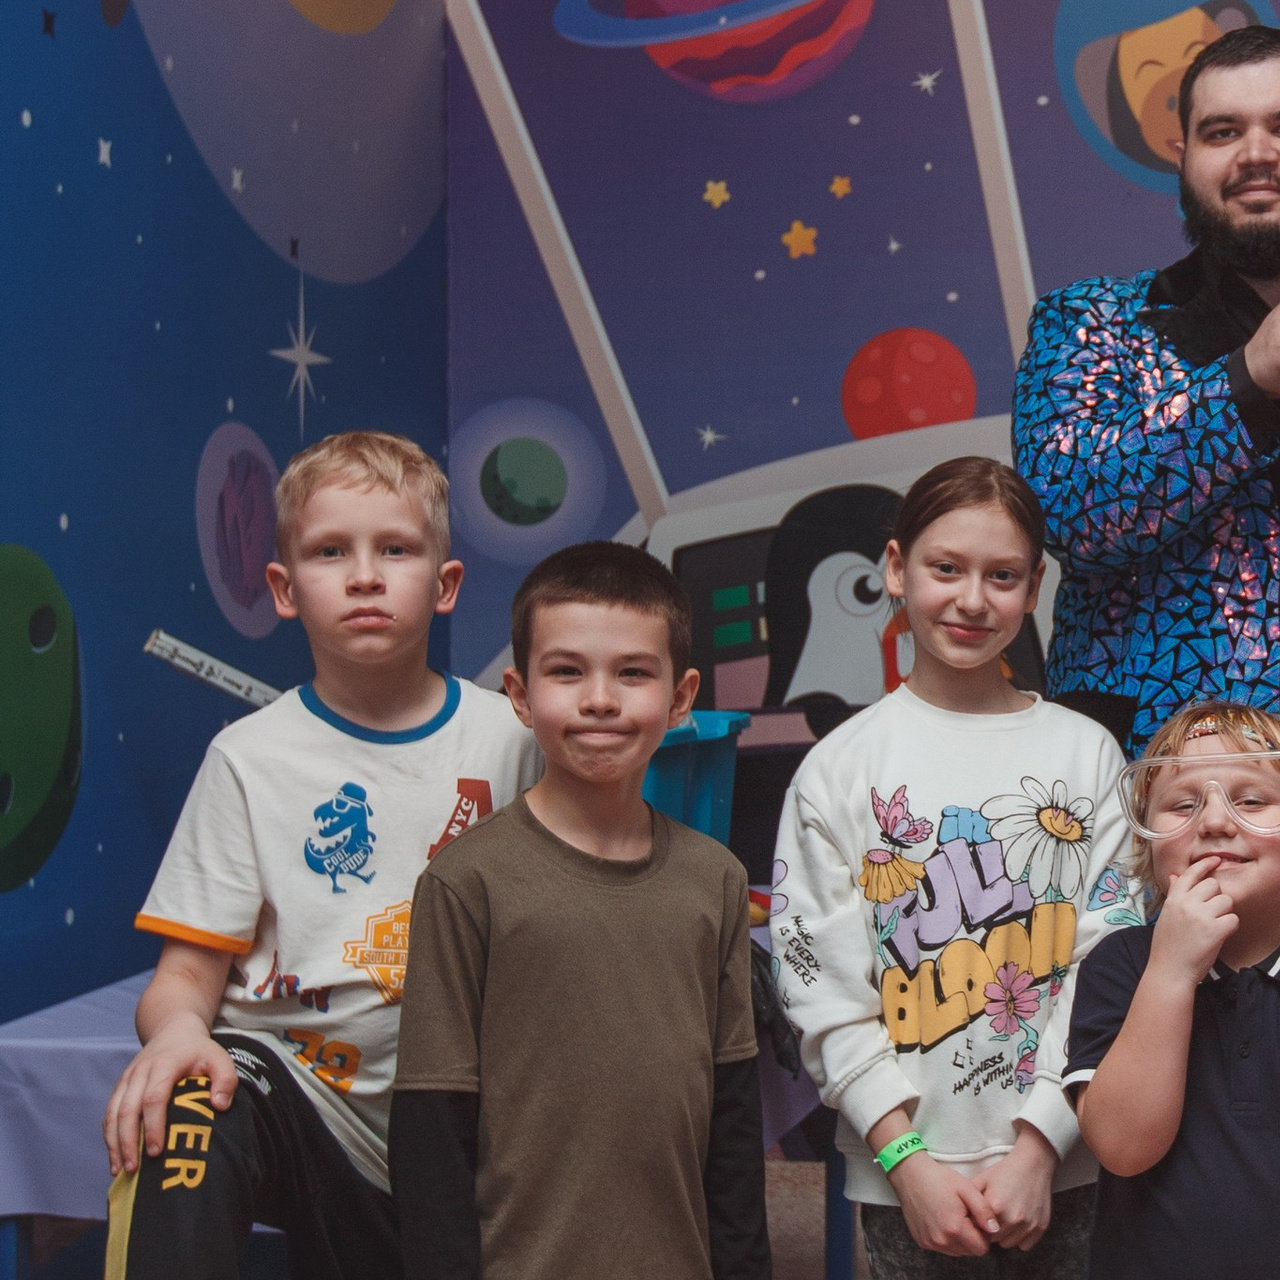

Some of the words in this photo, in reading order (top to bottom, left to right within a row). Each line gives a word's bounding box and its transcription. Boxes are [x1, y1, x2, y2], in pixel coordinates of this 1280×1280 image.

[448, 797, 473, 837] NYC
[938, 805, 993, 846] in
[323, 848, 350, 873] COOL
[340, 850, 367, 874] DUDE
[779, 926, 790, 937] IS
[363, 951, 395, 963] SOUTH
[783, 948, 817, 987] WHERE
[1001, 1075, 1014, 1090] US
